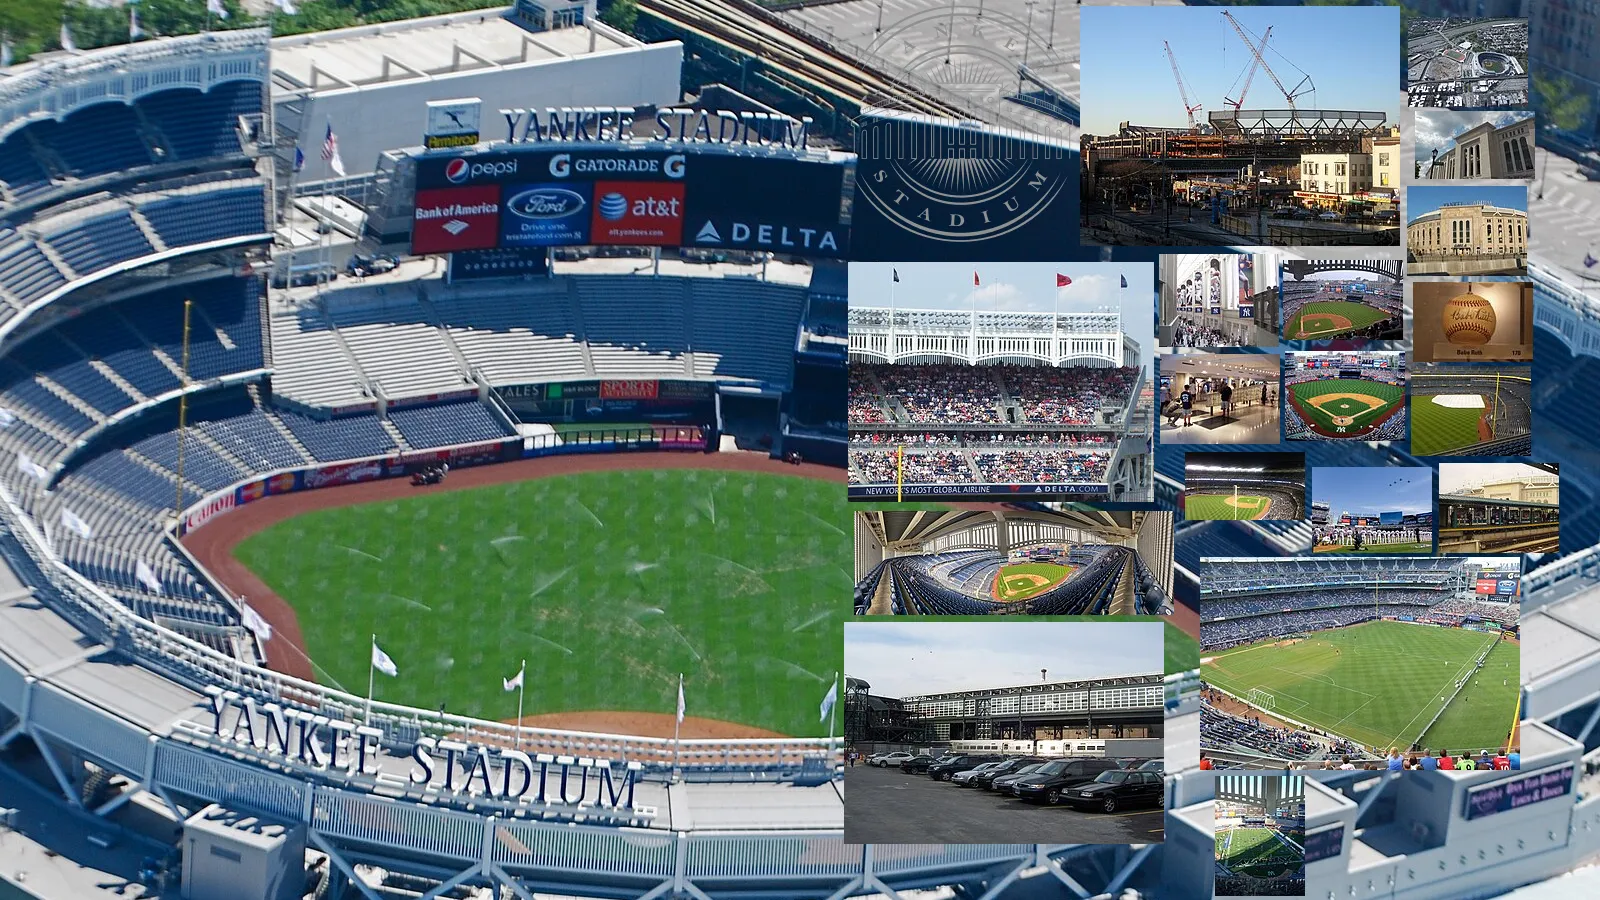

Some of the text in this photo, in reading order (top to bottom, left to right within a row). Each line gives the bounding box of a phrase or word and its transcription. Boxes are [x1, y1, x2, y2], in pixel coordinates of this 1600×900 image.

[498, 106, 815, 150] YANKEE STADIUM
[471, 159, 518, 179] pepsi
[575, 159, 659, 172] GATORADE
[415, 201, 499, 220] Bank of America
[524, 194, 568, 214] Ford
[632, 196, 680, 217] at&t
[521, 223, 546, 232] Drive
[732, 222, 838, 251] DELTA
[865, 487, 884, 495] NEW
[910, 486, 932, 494] MOST
[933, 486, 961, 494] GLOBAL
[962, 485, 991, 494] AIRLINE
[204, 684, 642, 808] YANKEE STADIUM
